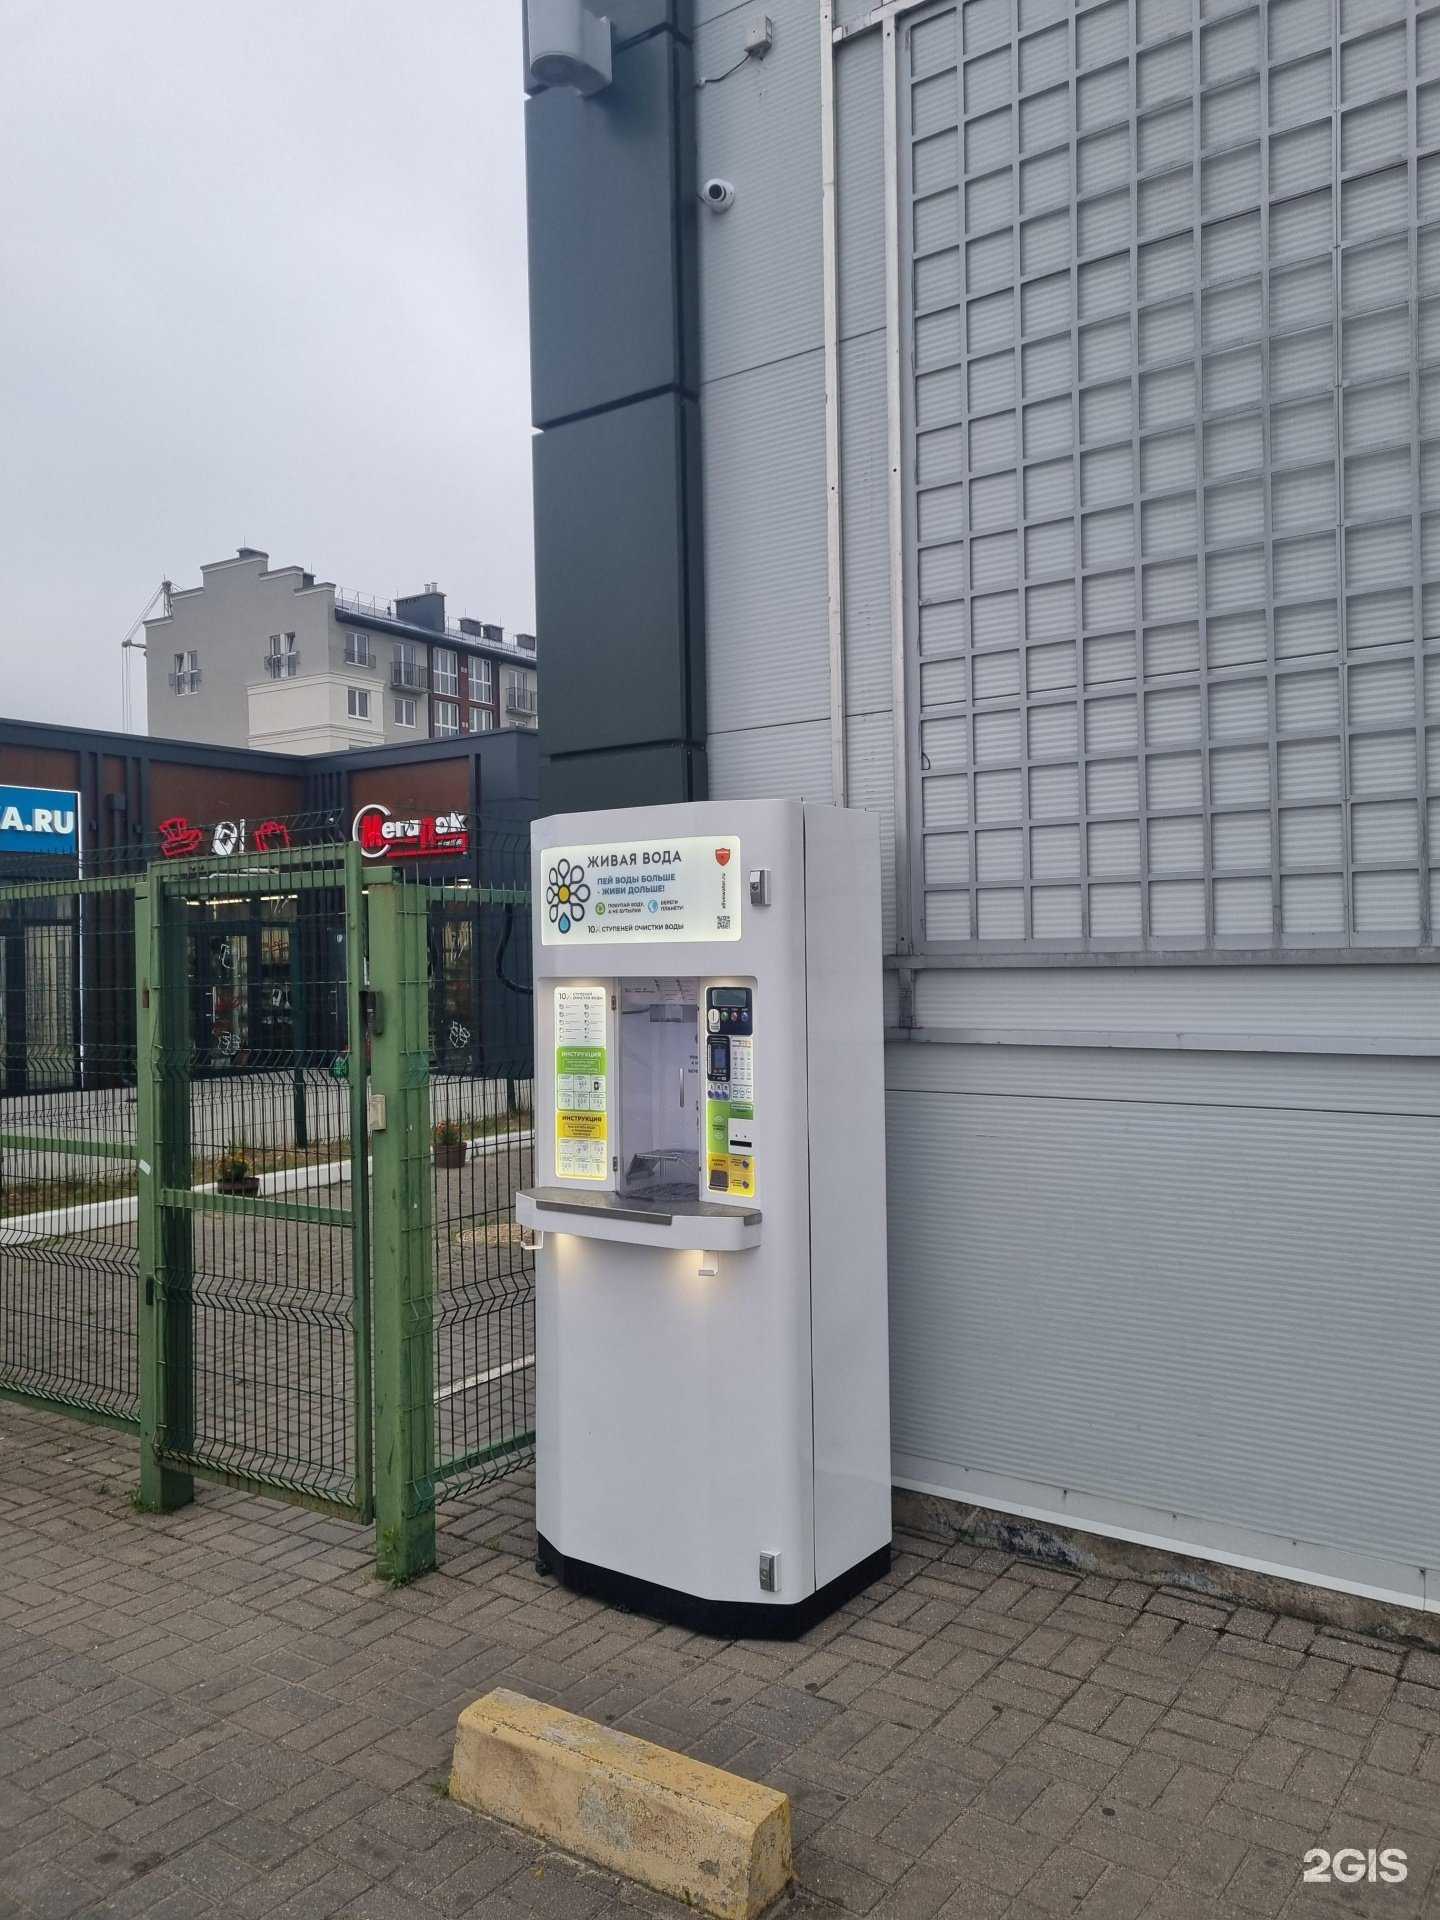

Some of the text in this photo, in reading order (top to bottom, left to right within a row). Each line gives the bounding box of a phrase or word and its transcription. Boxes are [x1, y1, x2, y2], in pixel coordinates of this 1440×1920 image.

[0, 806, 74, 835] A.RU
[587, 850, 682, 868] ЖИВАЯ ВОДА
[597, 873, 676, 885] ПЕЙ ВОДЫ БОЛЬШЕ
[602, 887, 626, 896] ЖИВИ
[628, 885, 665, 895] ДОЛЬШЕ!
[601, 924, 633, 933] СТУПЕНЕЙ
[634, 924, 664, 932] ОЧИСТКИ
[664, 923, 684, 932] ВОДЫ
